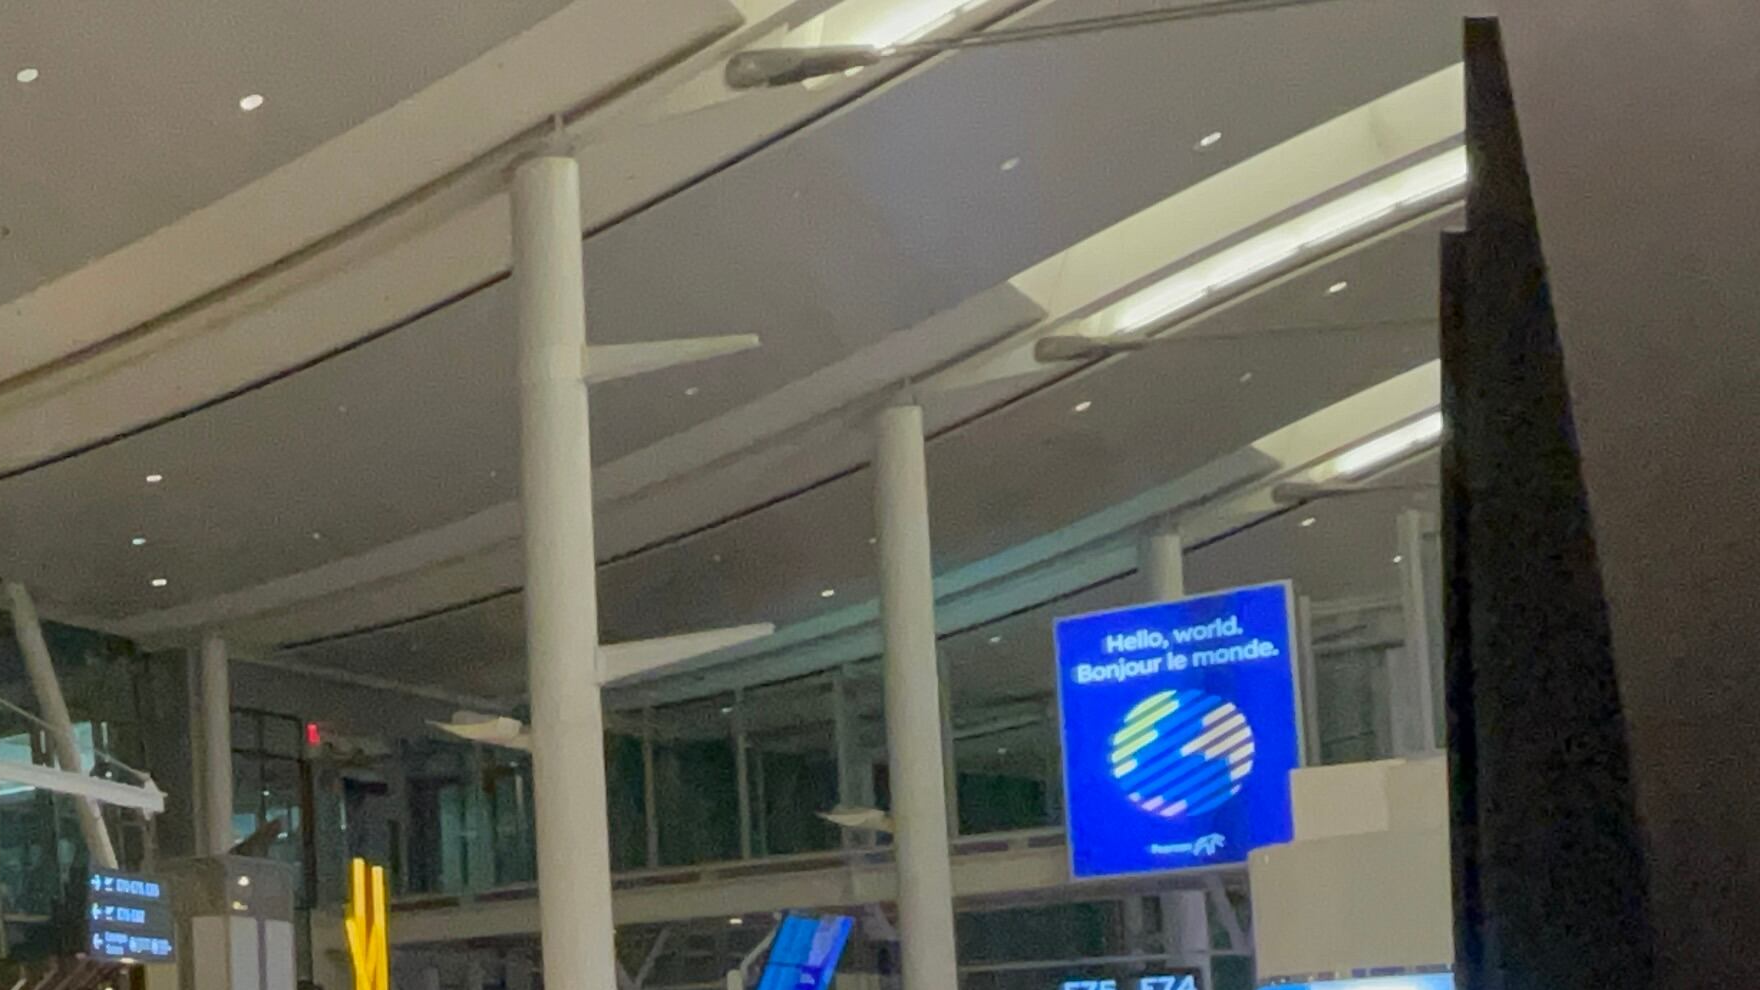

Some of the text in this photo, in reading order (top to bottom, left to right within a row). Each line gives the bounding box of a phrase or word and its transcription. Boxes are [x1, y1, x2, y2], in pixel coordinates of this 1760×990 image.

[1105, 615, 1244, 654] Hello, world.
[1076, 637, 1280, 684] Bonjour le monde.
